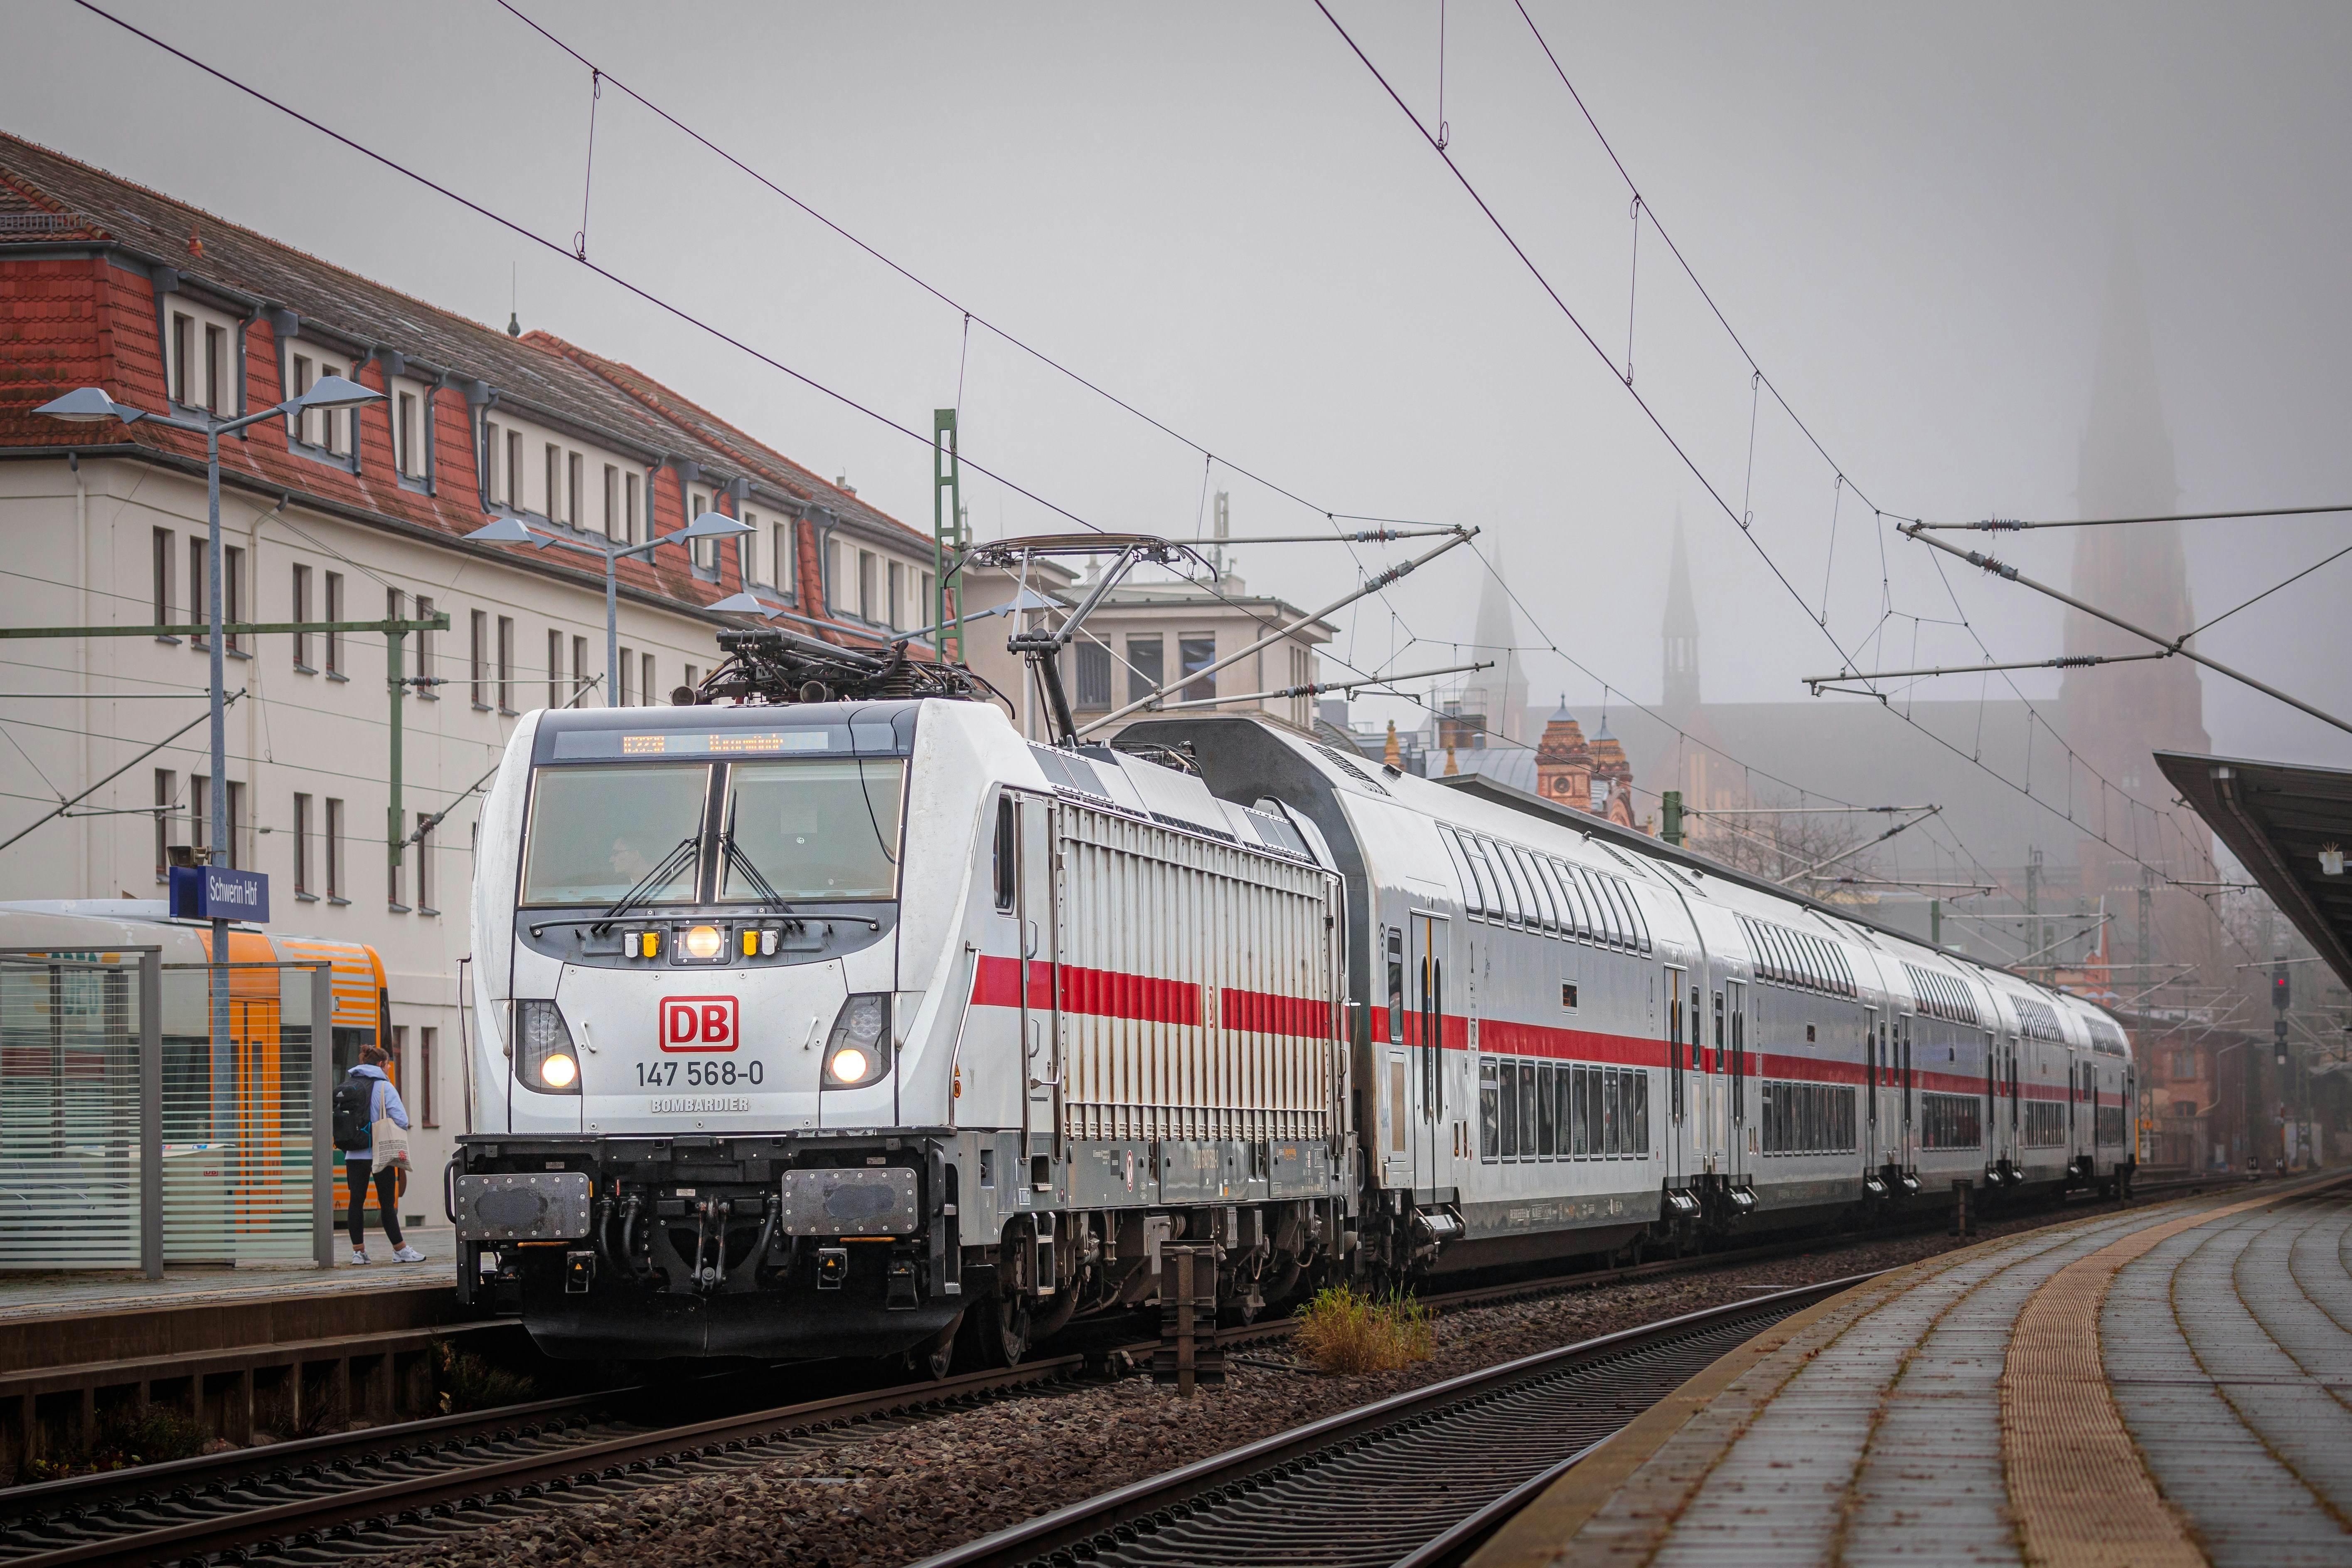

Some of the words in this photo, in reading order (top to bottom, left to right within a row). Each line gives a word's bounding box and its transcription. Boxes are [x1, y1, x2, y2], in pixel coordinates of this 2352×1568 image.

[210, 875, 243, 904] Schwerin
[245, 880, 257, 906] Hbf
[670, 1005, 729, 1043] DB
[636, 1061, 677, 1086] 147
[687, 1060, 764, 1086] 568-0
[651, 1098, 749, 1113] BOMBARDIER
